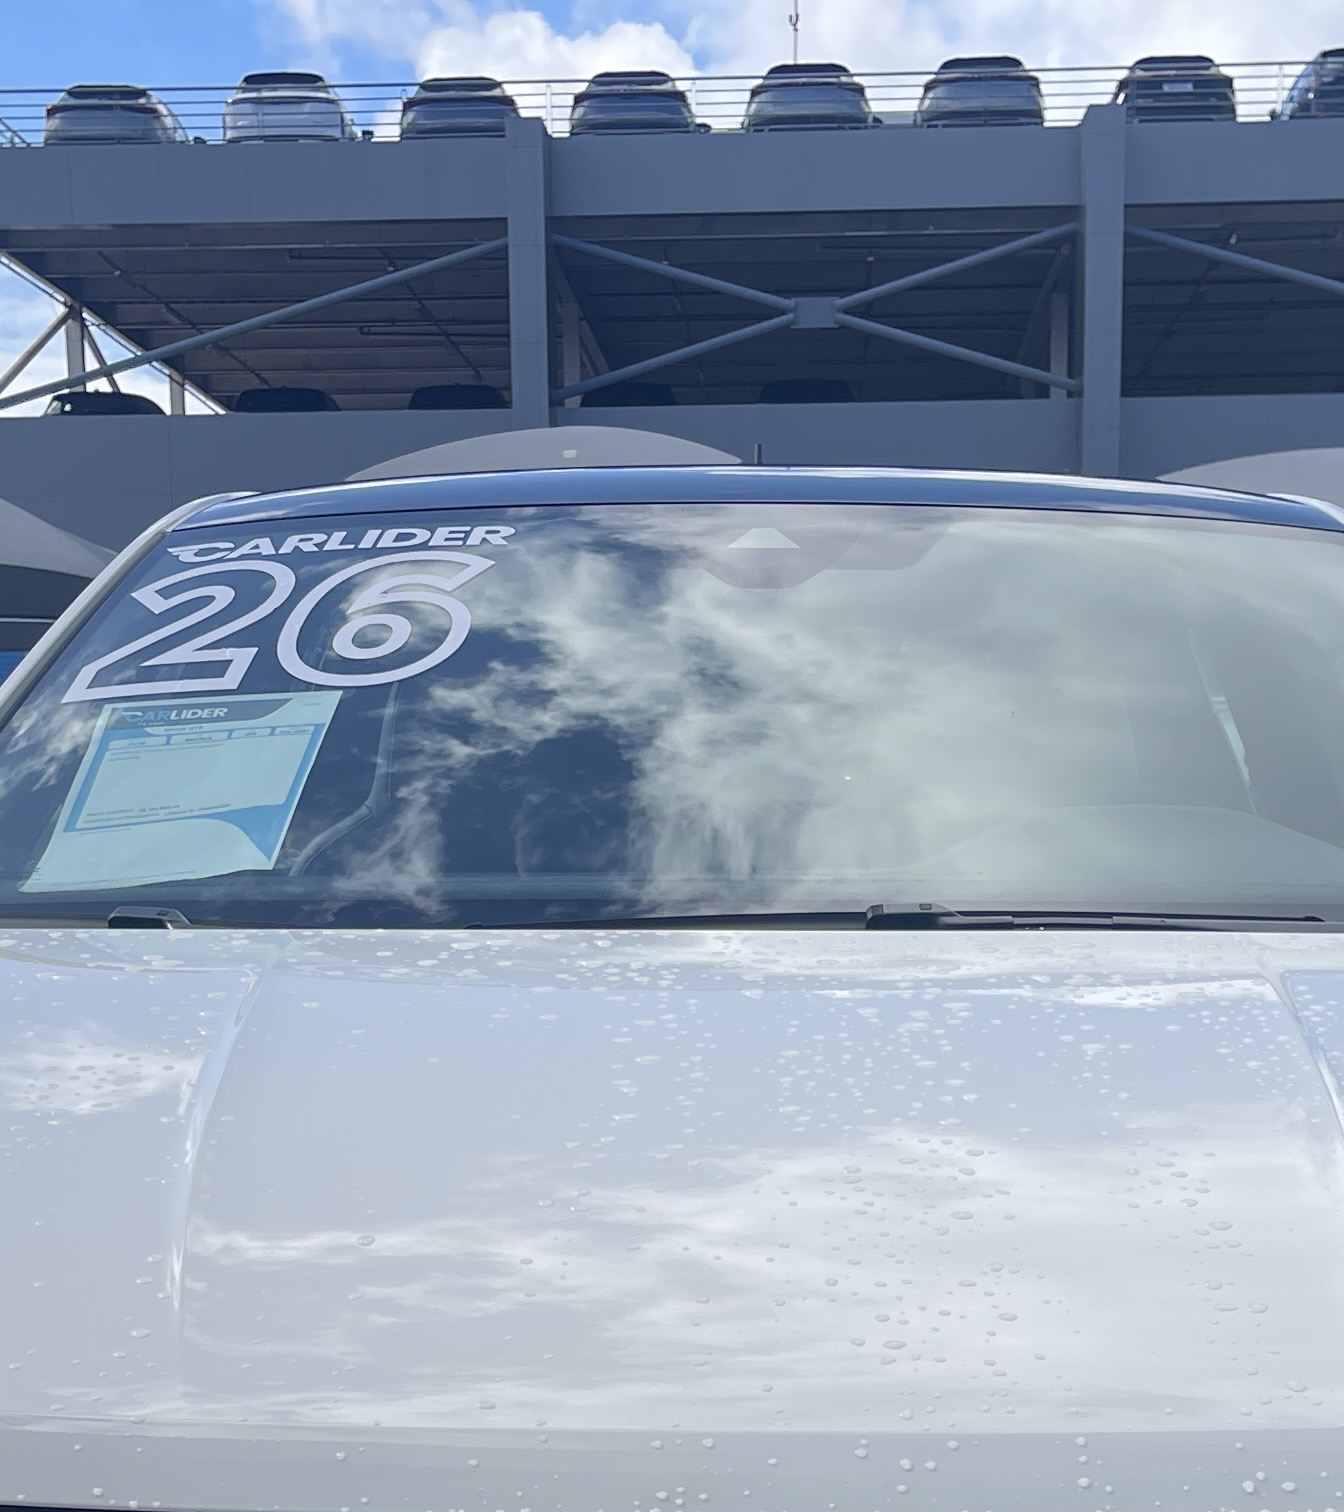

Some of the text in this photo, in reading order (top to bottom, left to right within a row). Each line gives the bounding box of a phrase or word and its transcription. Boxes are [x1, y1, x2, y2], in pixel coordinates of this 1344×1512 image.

[166, 525, 516, 563] CARLIDER
[61, 550, 496, 704] 26
[121, 707, 229, 723] CARLIDER
